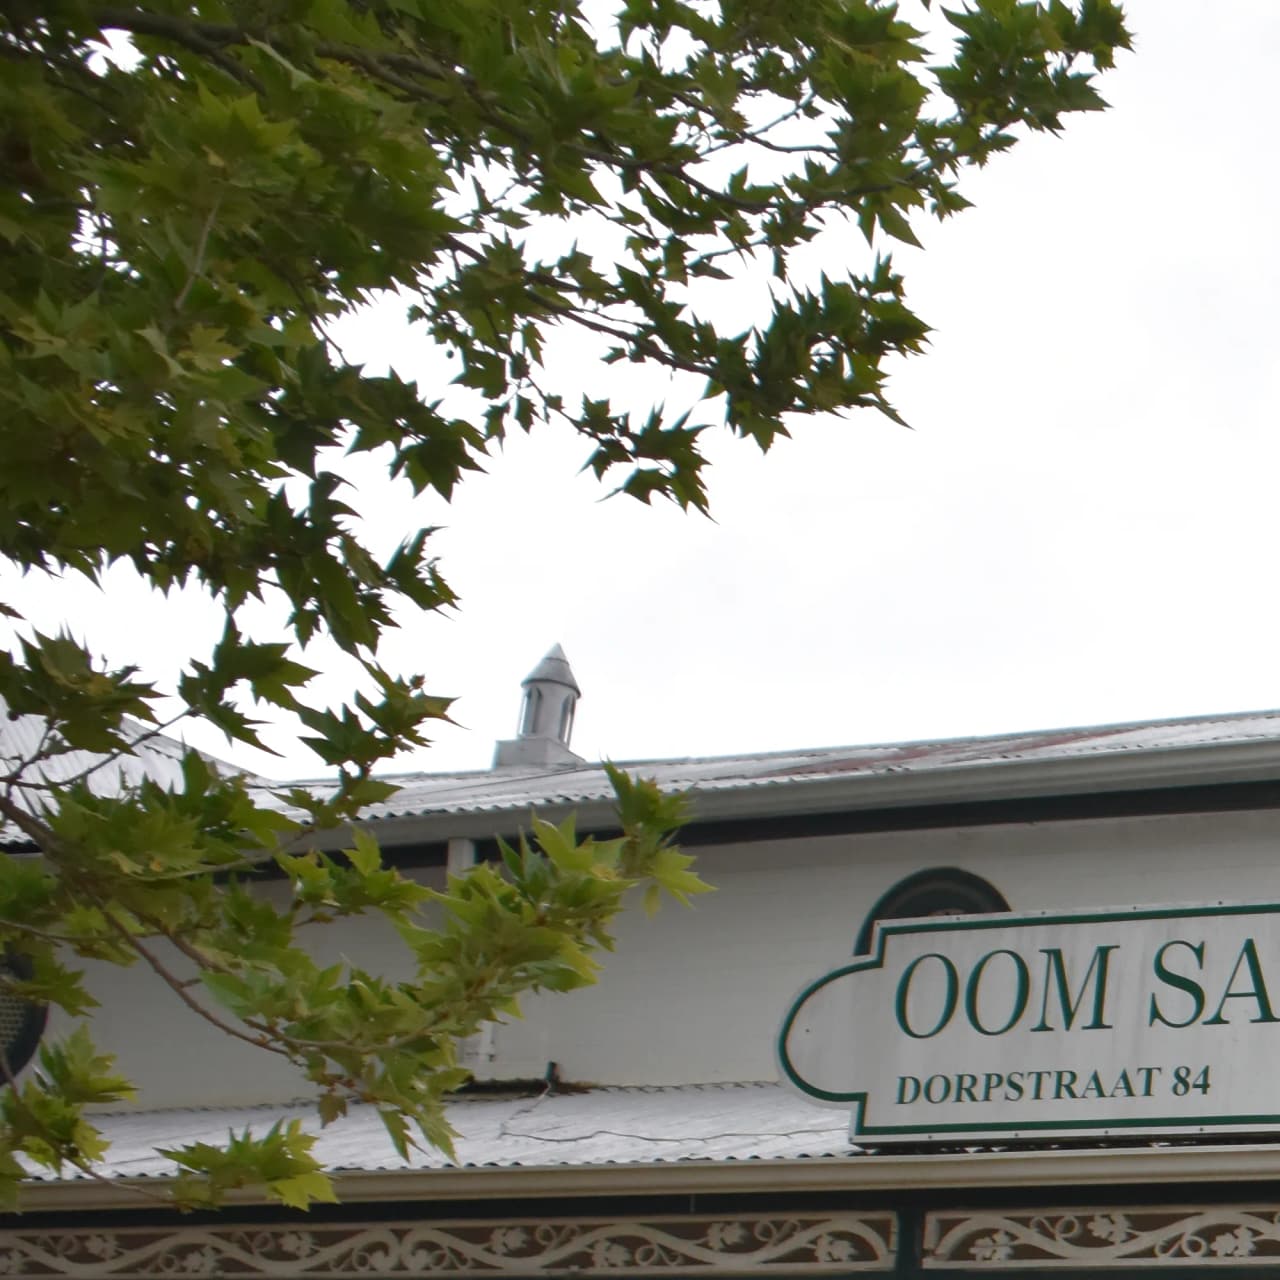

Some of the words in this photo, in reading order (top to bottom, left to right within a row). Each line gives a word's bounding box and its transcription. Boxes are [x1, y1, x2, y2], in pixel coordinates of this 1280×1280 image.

[894, 944, 1120, 1039] OOM
[895, 1066, 1162, 1105] DORPSTRAAT
[1171, 1064, 1212, 1096] 84
